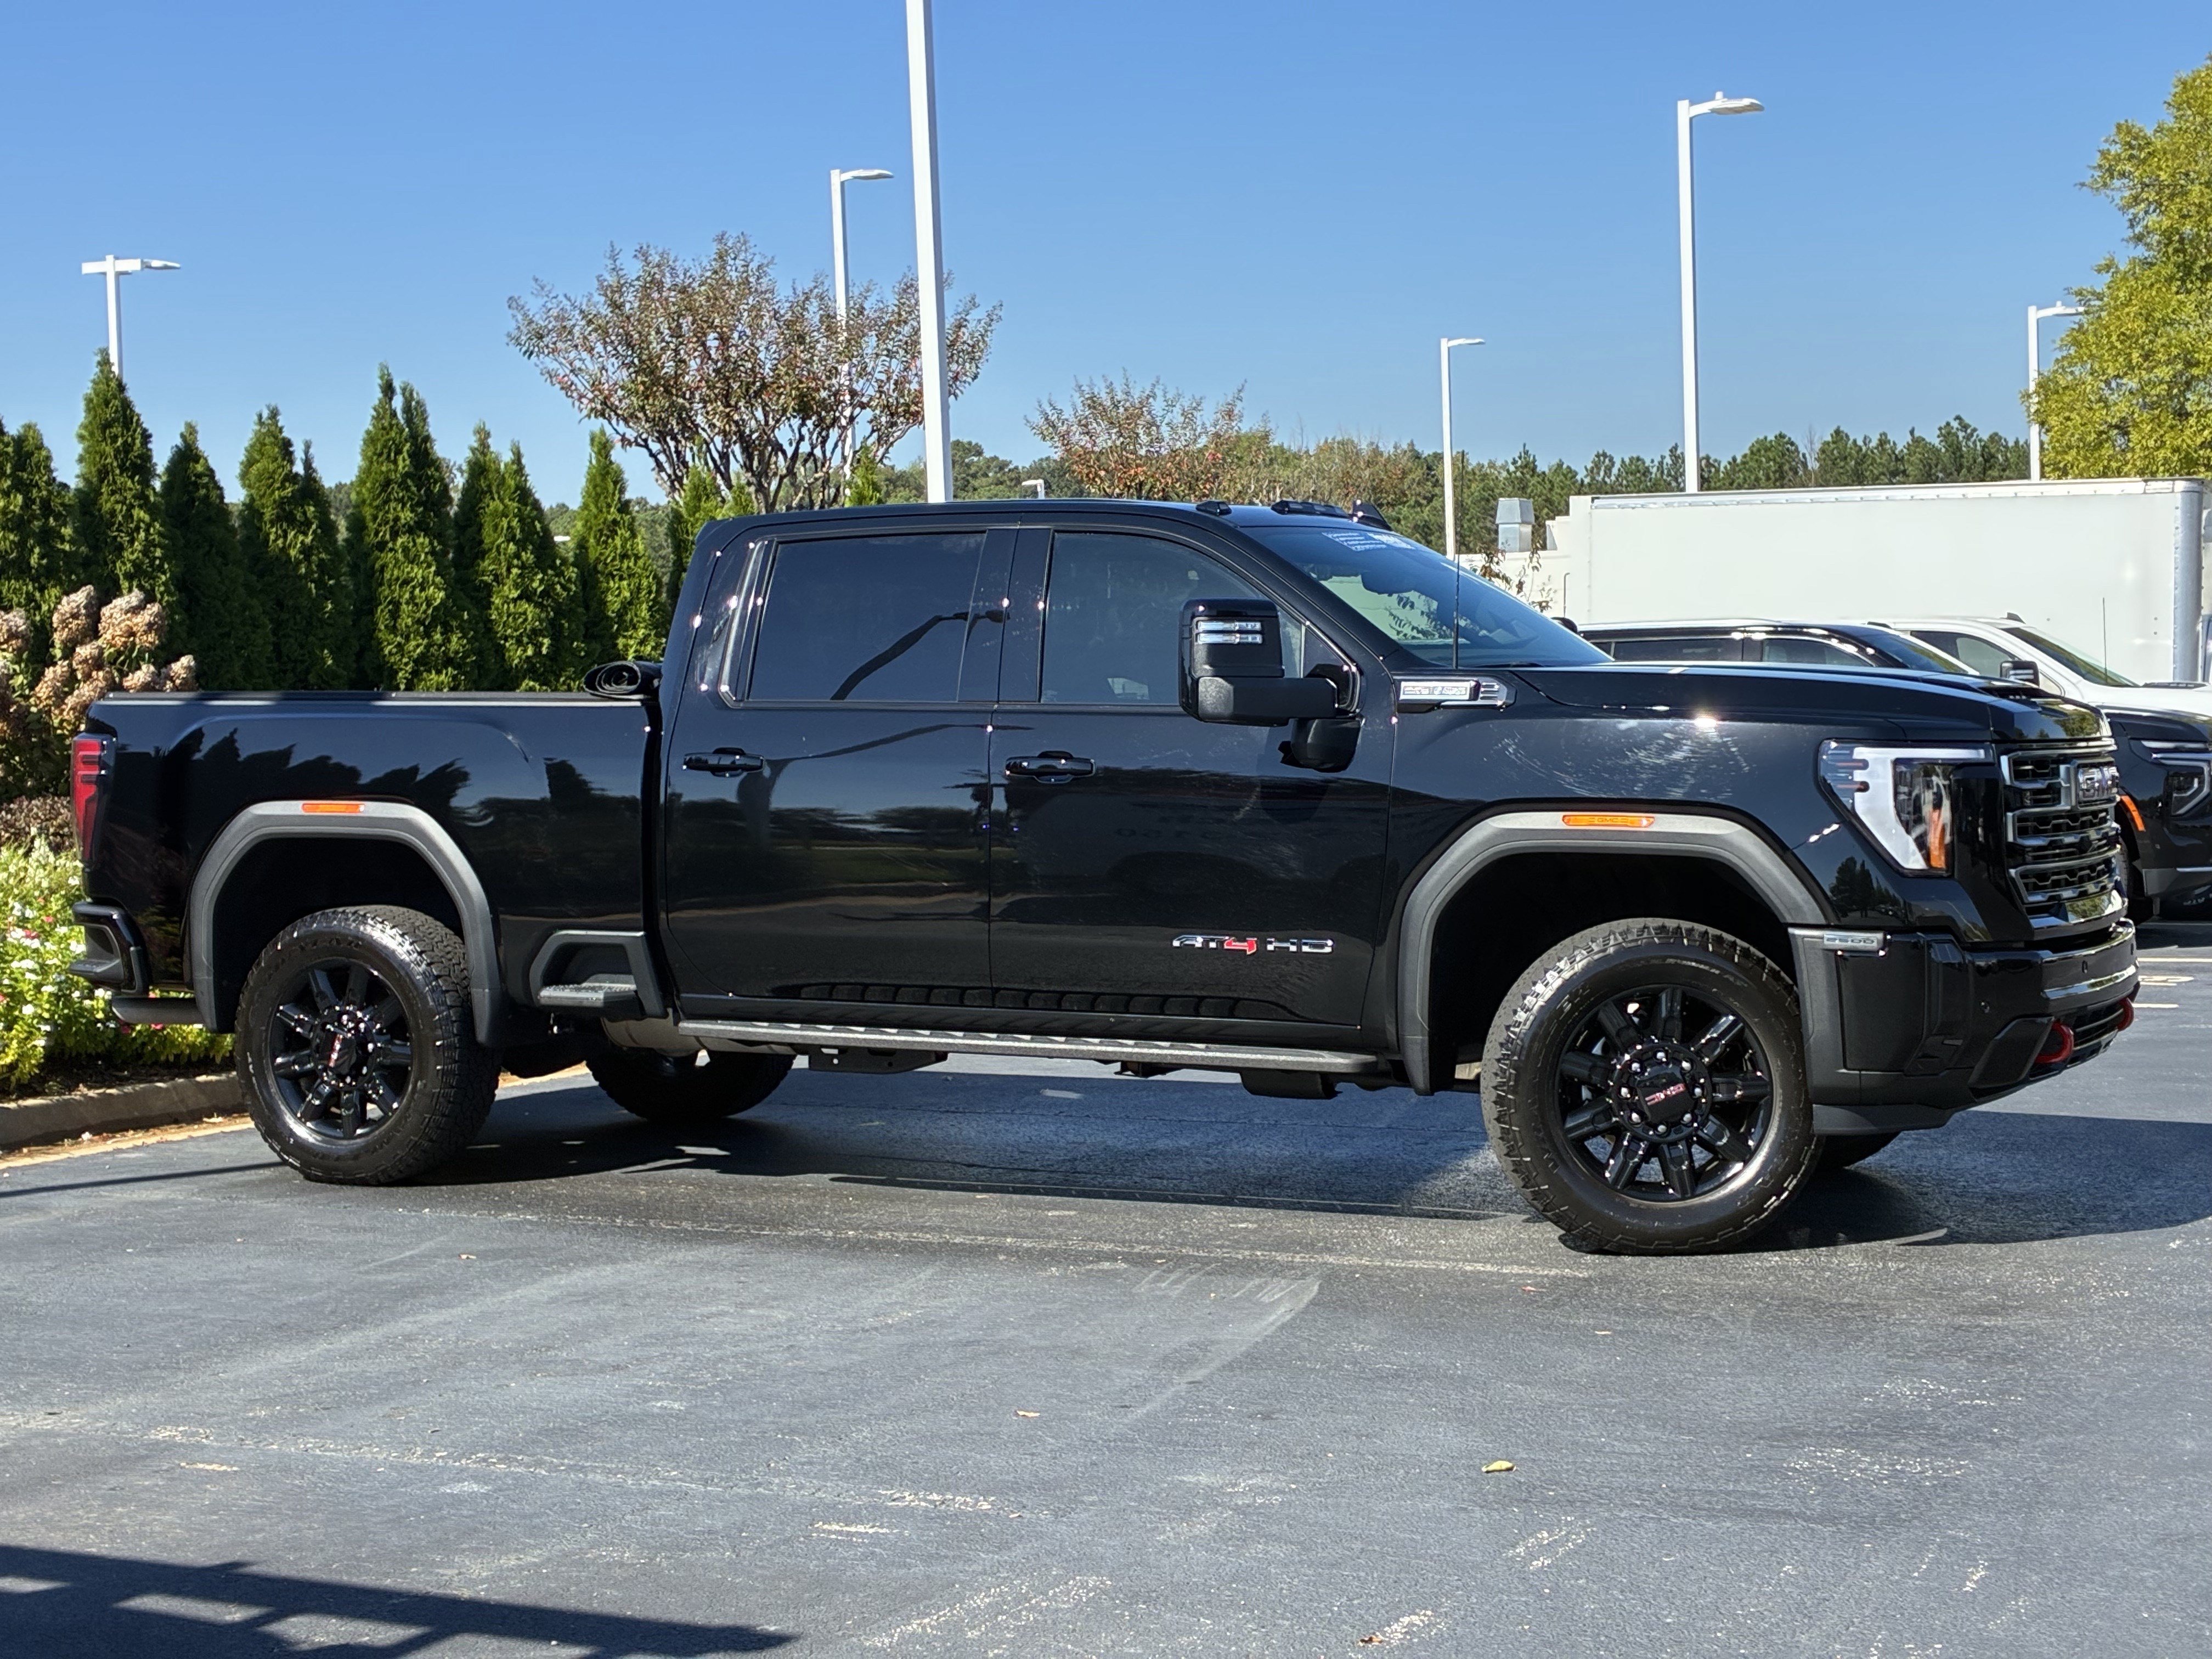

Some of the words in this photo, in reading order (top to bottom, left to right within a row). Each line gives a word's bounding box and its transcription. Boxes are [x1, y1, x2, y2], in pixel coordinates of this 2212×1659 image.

[1172, 934, 1258, 955] AT4
[1266, 938, 1334, 953] HD
[1645, 1083, 1686, 1106] GMC
